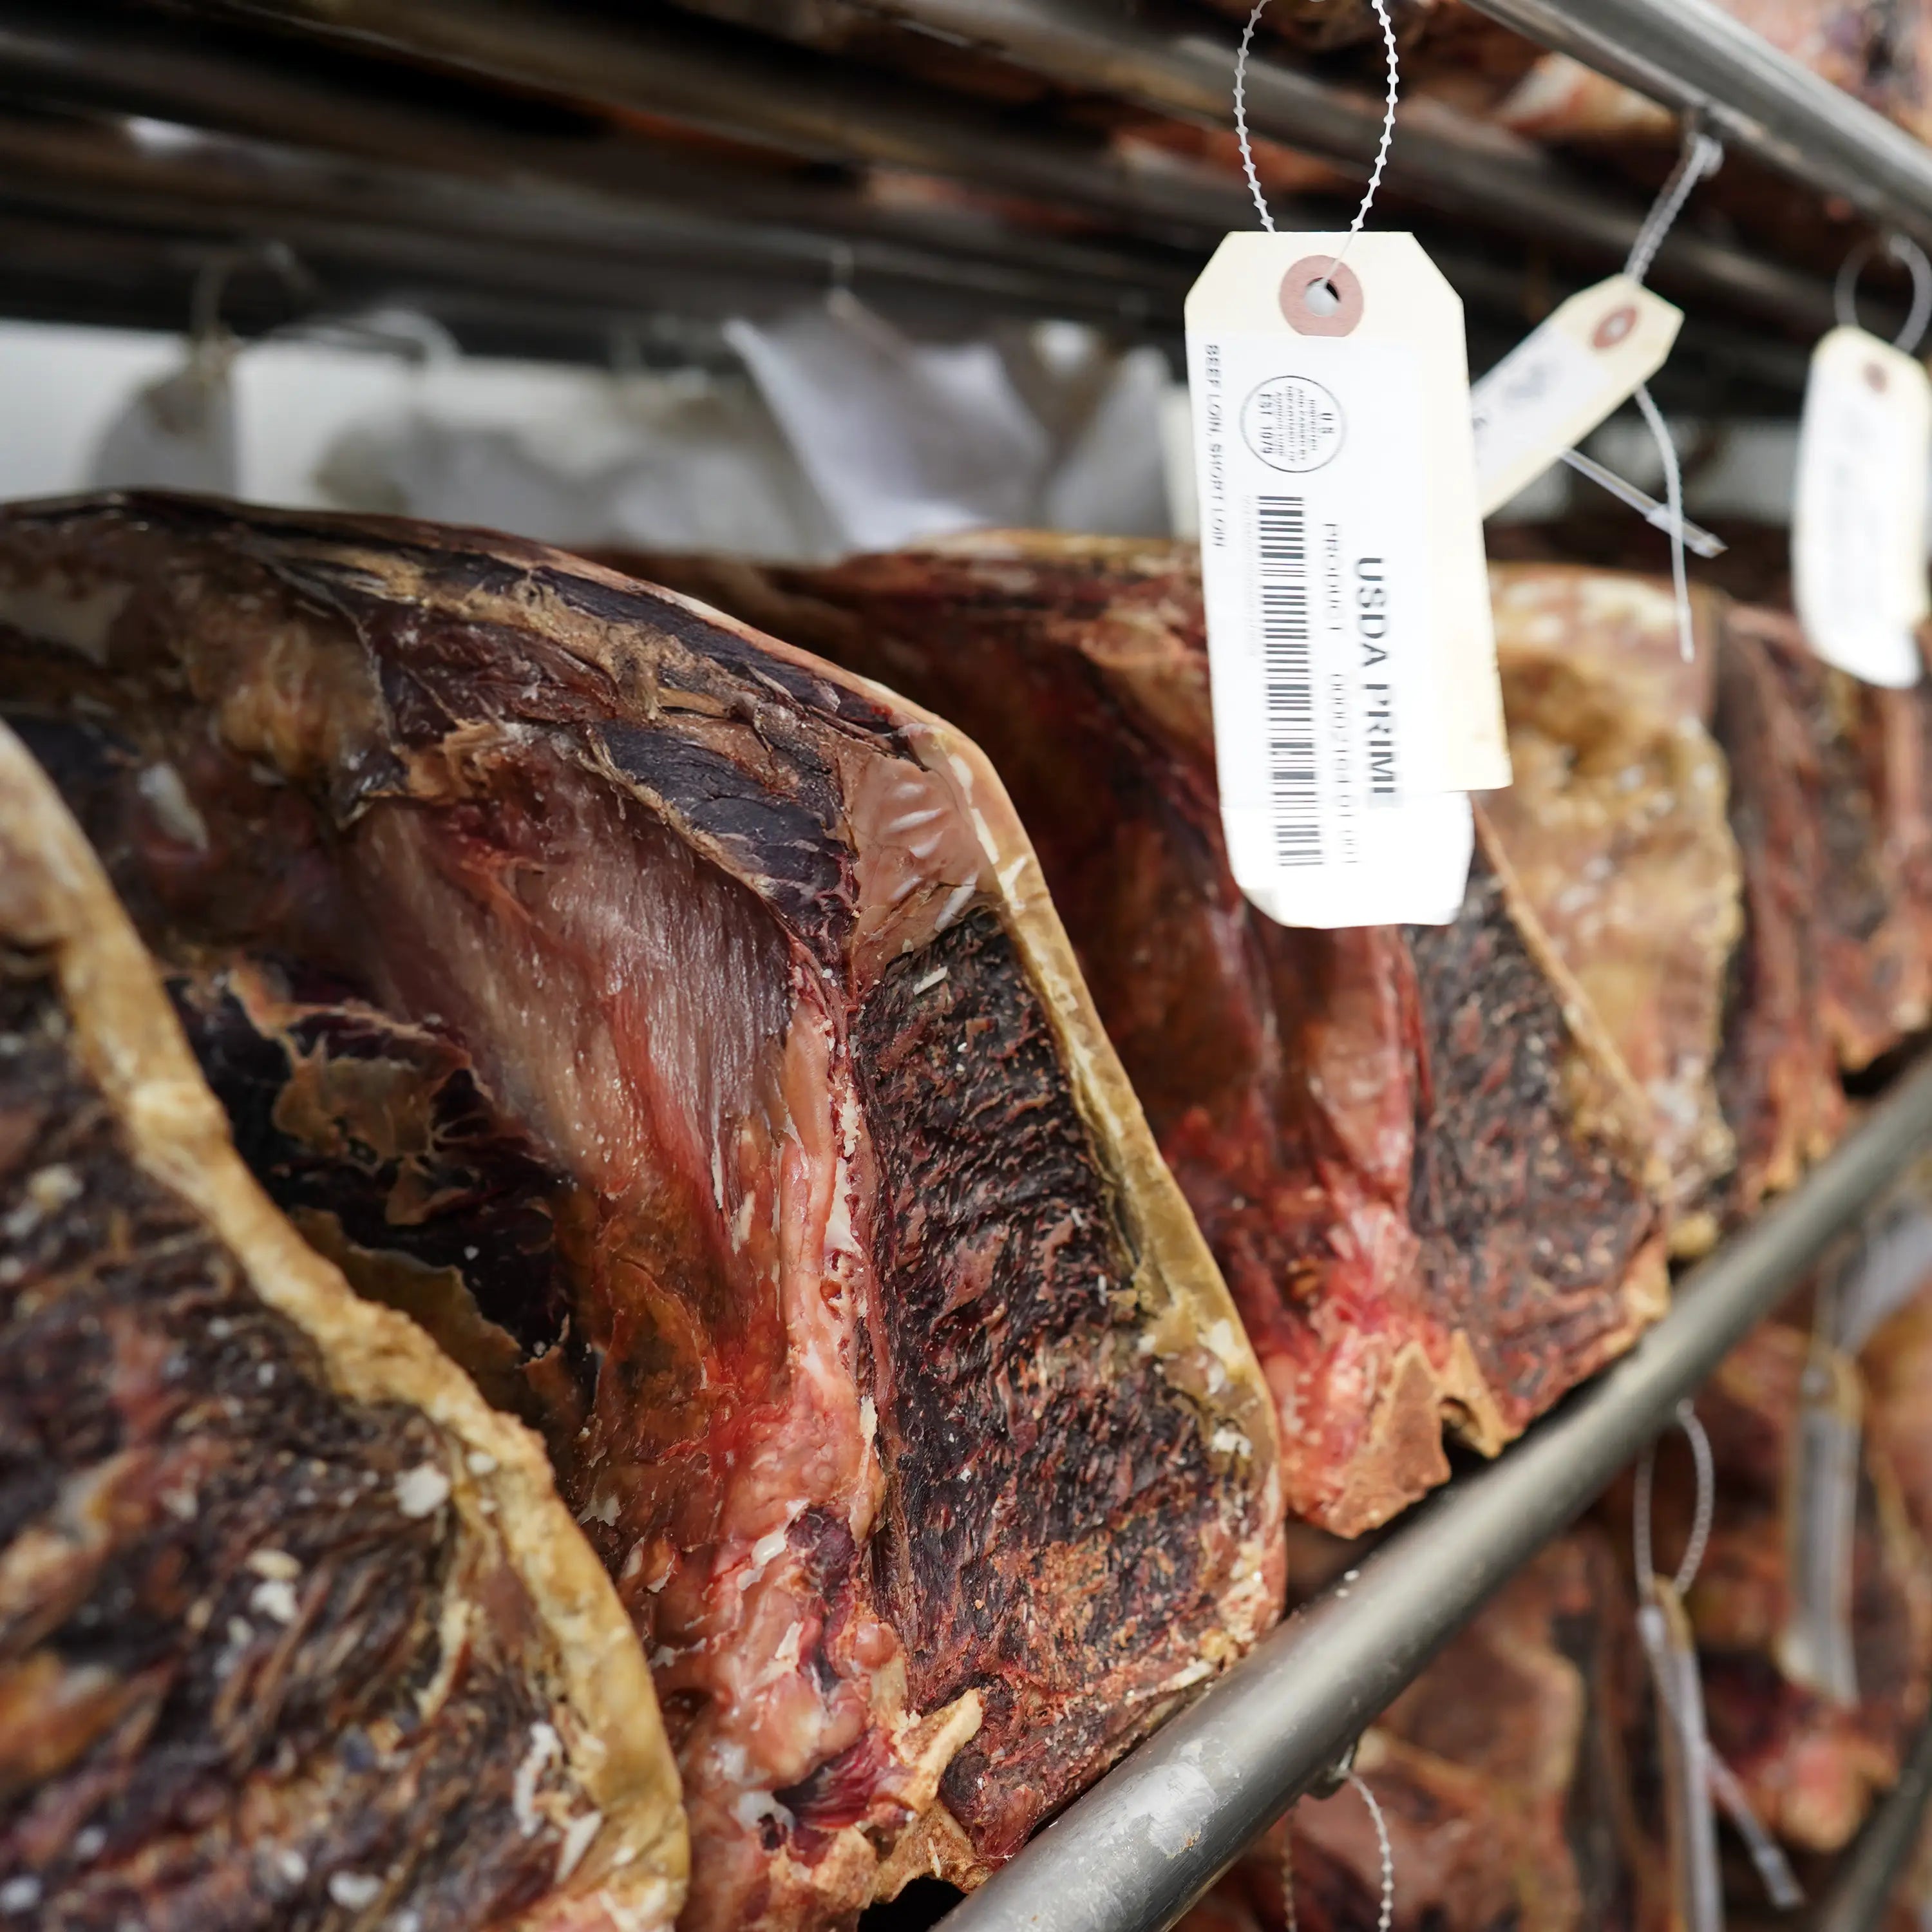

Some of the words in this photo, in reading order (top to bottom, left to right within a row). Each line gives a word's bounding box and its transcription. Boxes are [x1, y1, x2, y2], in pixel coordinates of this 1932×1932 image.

[1205, 343, 1222, 388] BEEF
[1206, 393, 1224, 437] LOIN,
[1209, 442, 1225, 503] SHORT
[1211, 507, 1226, 547] LOIN
[1323, 524, 1343, 634] PRODUCT
[1356, 557, 1387, 667] USDA
[1363, 683, 1399, 808] PRIME
